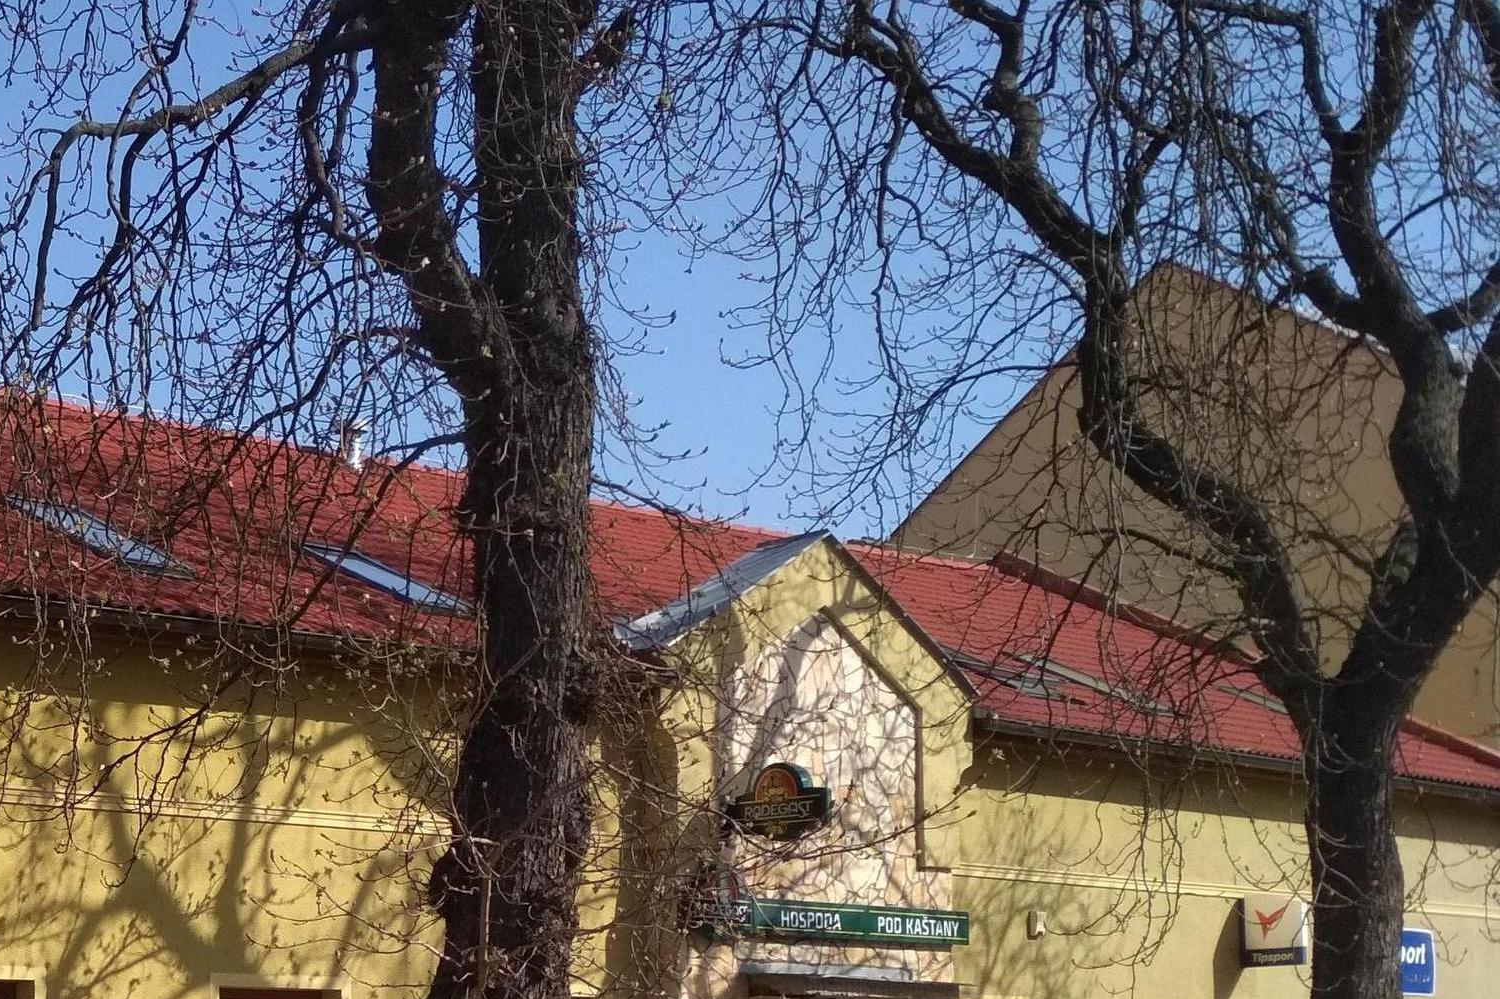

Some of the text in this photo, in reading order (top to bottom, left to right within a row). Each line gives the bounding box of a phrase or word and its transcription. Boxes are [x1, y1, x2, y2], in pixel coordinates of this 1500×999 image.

[744, 800, 814, 821] RADEGAST
[780, 910, 960, 938] HOSPODA POD KAŠTANY
[1252, 952, 1294, 965] Tipsport
